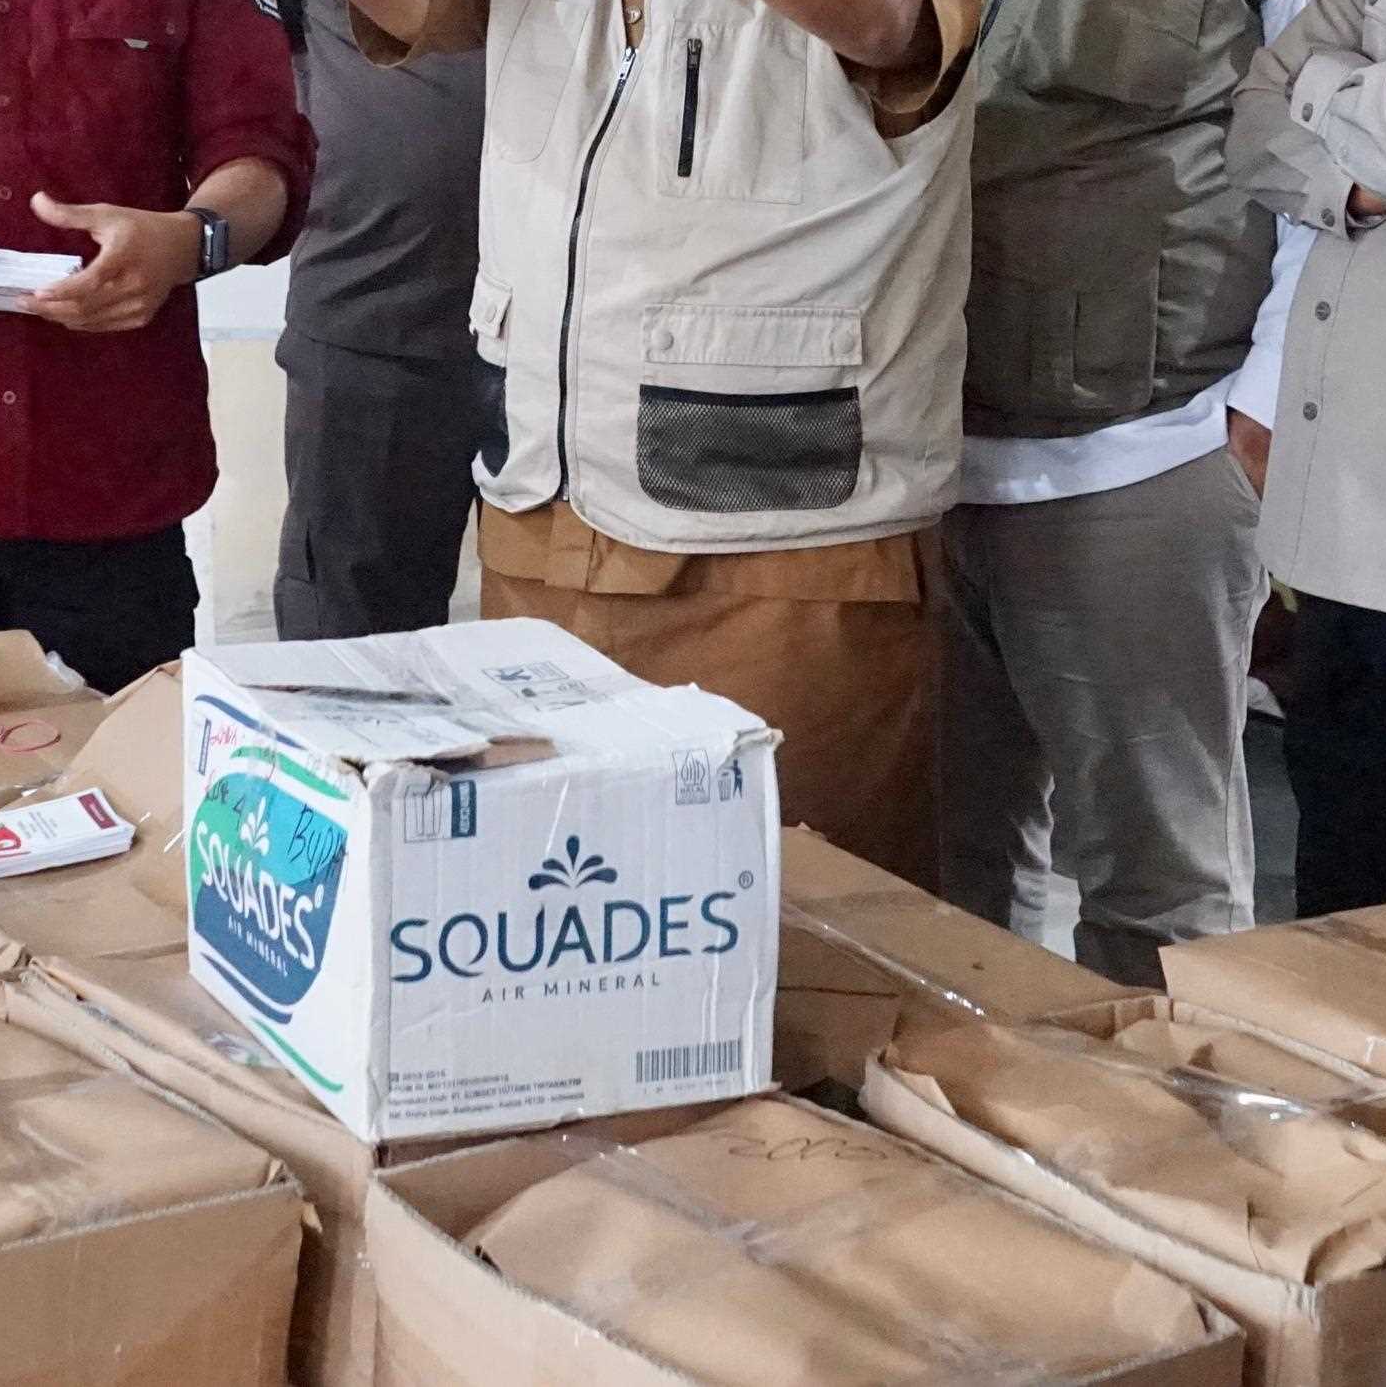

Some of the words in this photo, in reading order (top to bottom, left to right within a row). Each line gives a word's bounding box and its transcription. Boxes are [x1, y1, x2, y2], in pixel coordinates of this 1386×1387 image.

[196, 820, 316, 971] SQUADES
[246, 930, 289, 978] MINERAL
[389, 891, 739, 983] SQUADES
[481, 986, 525, 1004] AIR
[543, 971, 662, 998] MINERAL
